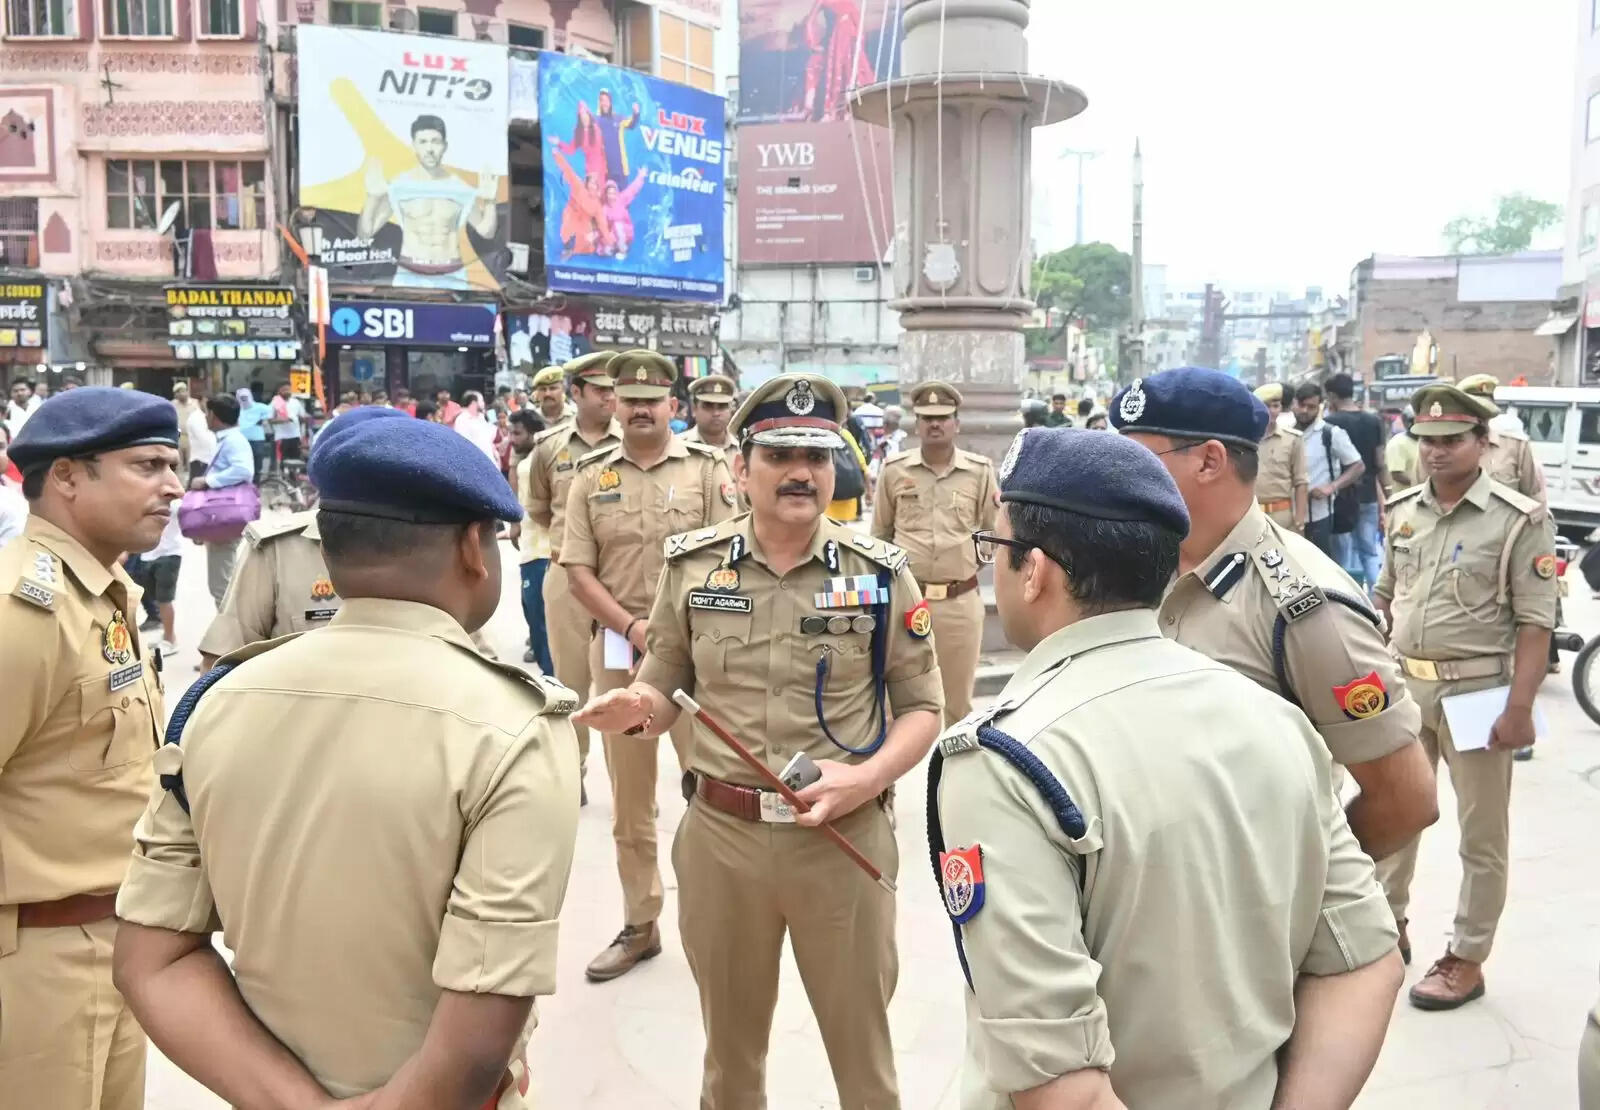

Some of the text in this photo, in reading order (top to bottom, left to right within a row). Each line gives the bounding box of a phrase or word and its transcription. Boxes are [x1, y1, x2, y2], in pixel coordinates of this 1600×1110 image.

[403, 51, 470, 72] LUX
[658, 109, 706, 136] LUX
[640, 125, 723, 165] VENUS
[757, 142, 815, 167] YWB
[167, 289, 219, 305] BADAL
[363, 307, 414, 339] SBI
[692, 596, 747, 609] MOHIT AGARWAL
